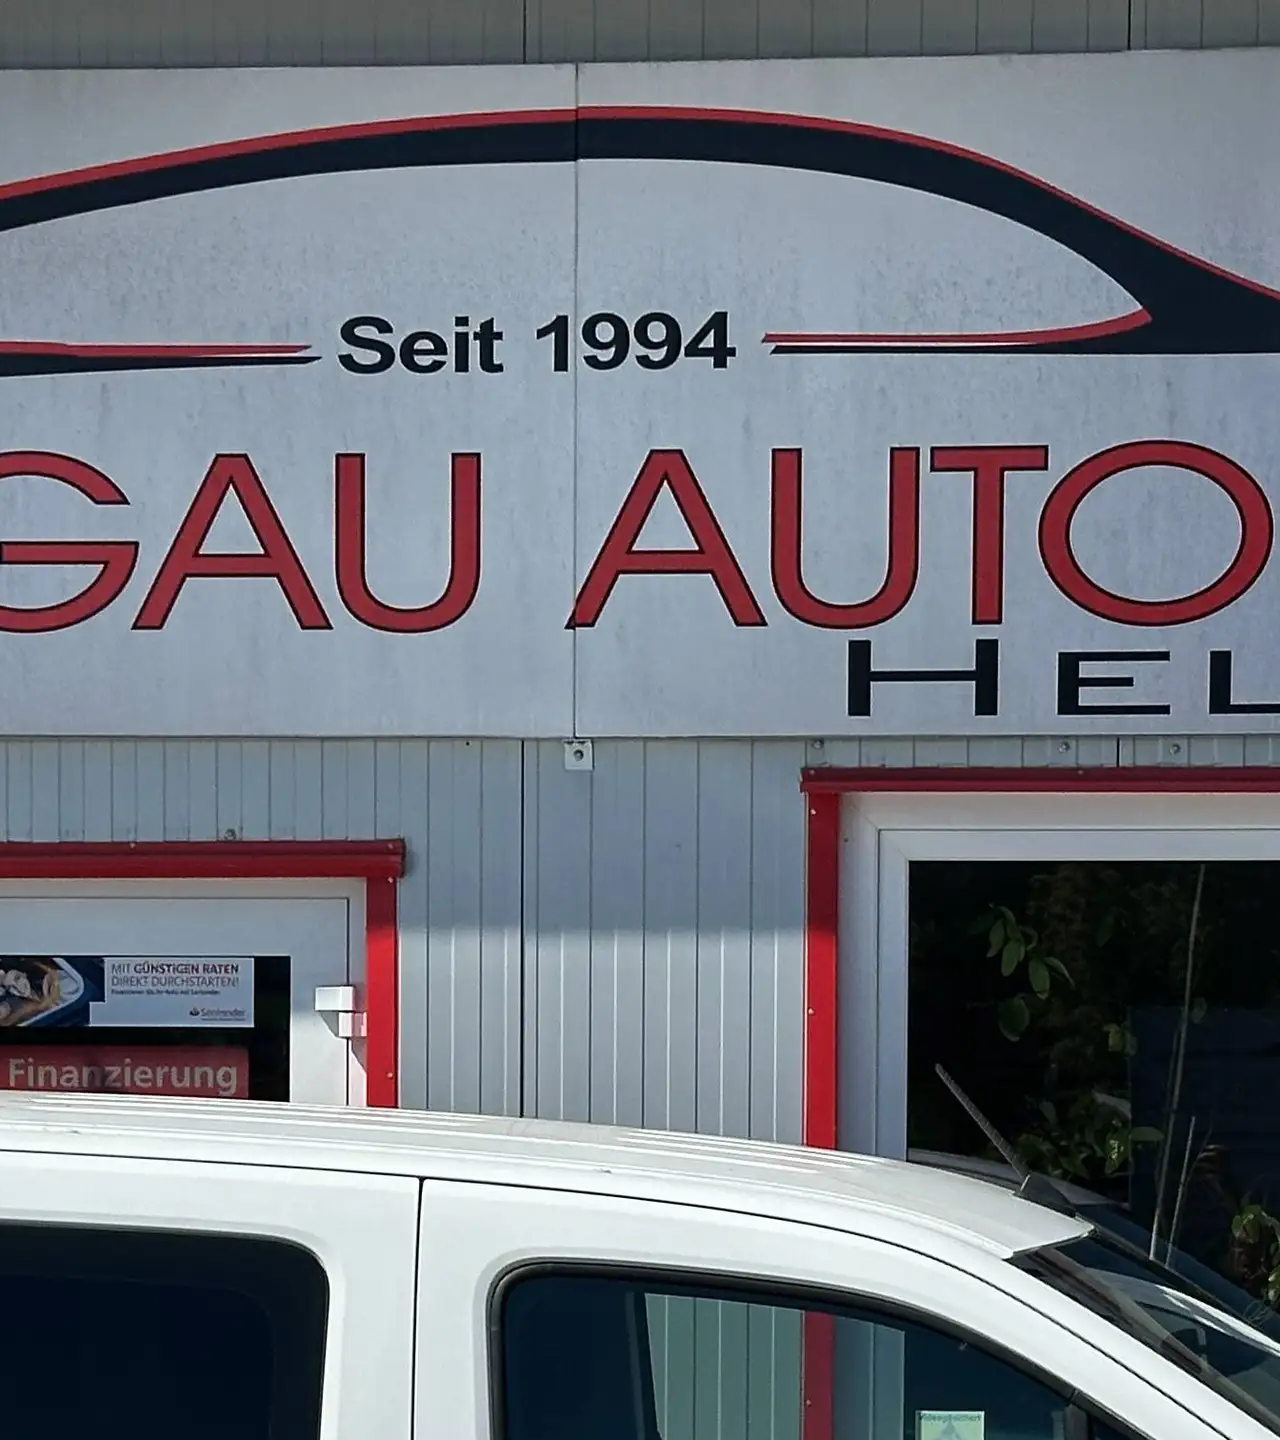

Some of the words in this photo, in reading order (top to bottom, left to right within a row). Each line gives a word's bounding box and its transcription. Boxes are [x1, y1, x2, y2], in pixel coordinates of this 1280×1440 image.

[339, 316, 504, 374] Seit
[537, 312, 736, 371] 1994
[111, 964, 131, 974] MIT
[133, 961, 199, 974] GÜNSTIGEN
[202, 963, 239, 974] RATEN
[111, 976, 149, 987] DIREKT
[9, 1057, 237, 1095] Finanzierung
